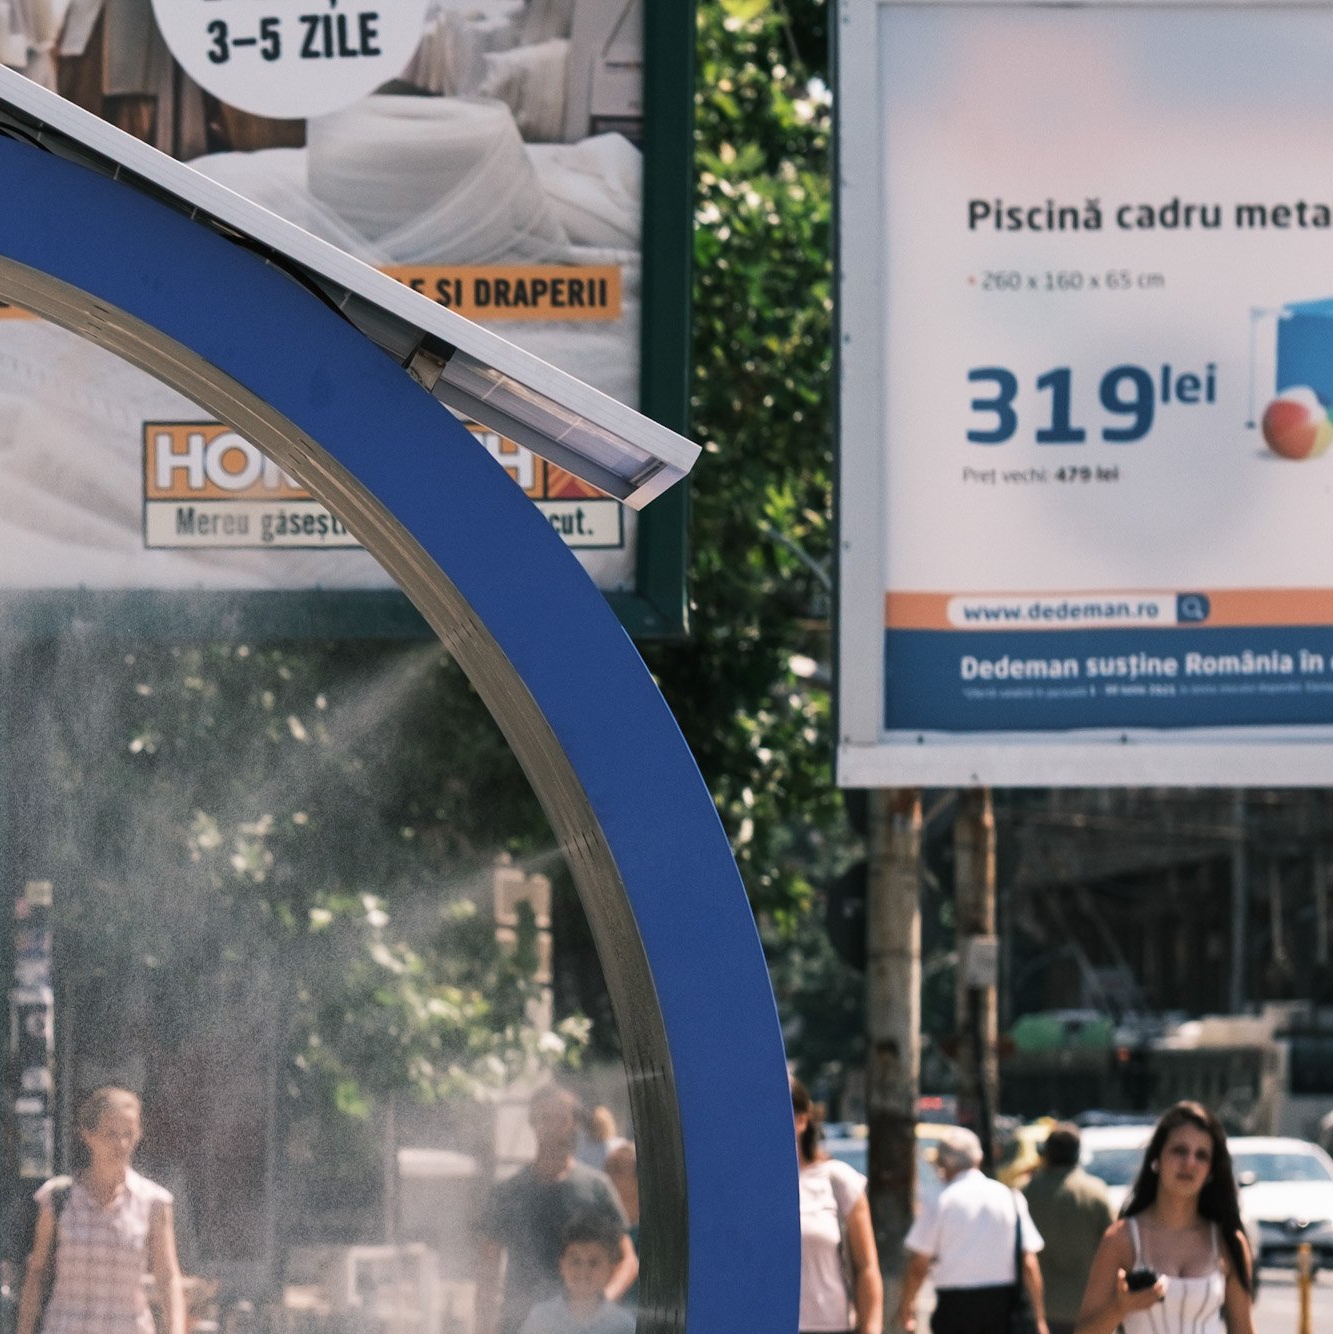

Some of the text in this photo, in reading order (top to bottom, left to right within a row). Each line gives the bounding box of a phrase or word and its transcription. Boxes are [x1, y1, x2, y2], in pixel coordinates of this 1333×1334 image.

[299, 12, 381, 59] ZILE
[967, 198, 1103, 231] Piscină
[1116, 198, 1222, 230] cadru
[473, 278, 608, 308] DRAPERII
[981, 270, 1022, 291] 260
[1045, 270, 1083, 291] 160
[1105, 268, 1132, 290] 65
[1137, 271, 1165, 289] cm
[965, 363, 1217, 445] 319 lei
[1054, 465, 1091, 484] 479
[1095, 464, 1119, 484] lei
[175, 506, 250, 536] Mereu
[962, 601, 1160, 624] www.dedeman.ro
[960, 653, 1080, 681] Dedeman
[1185, 648, 1295, 677] România
